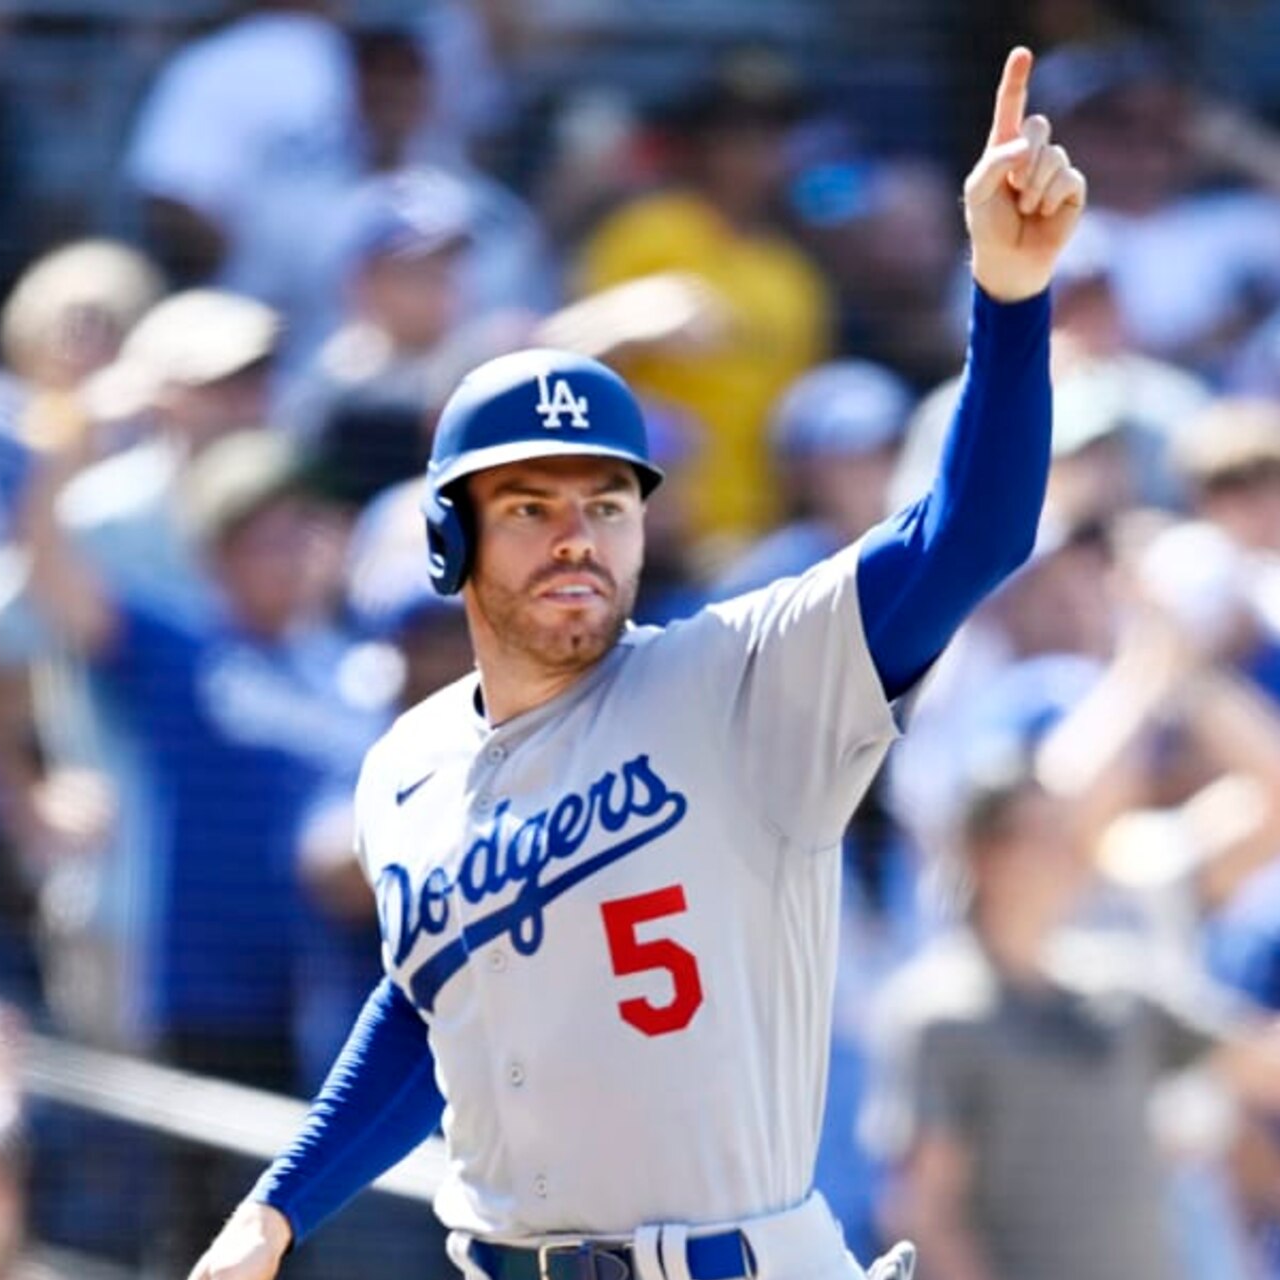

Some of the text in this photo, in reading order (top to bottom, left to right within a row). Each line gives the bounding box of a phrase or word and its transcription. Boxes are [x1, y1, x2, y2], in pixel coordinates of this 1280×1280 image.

[535, 372, 590, 429] LA
[376, 754, 687, 968] Dodgers
[600, 884, 704, 1037] 5
